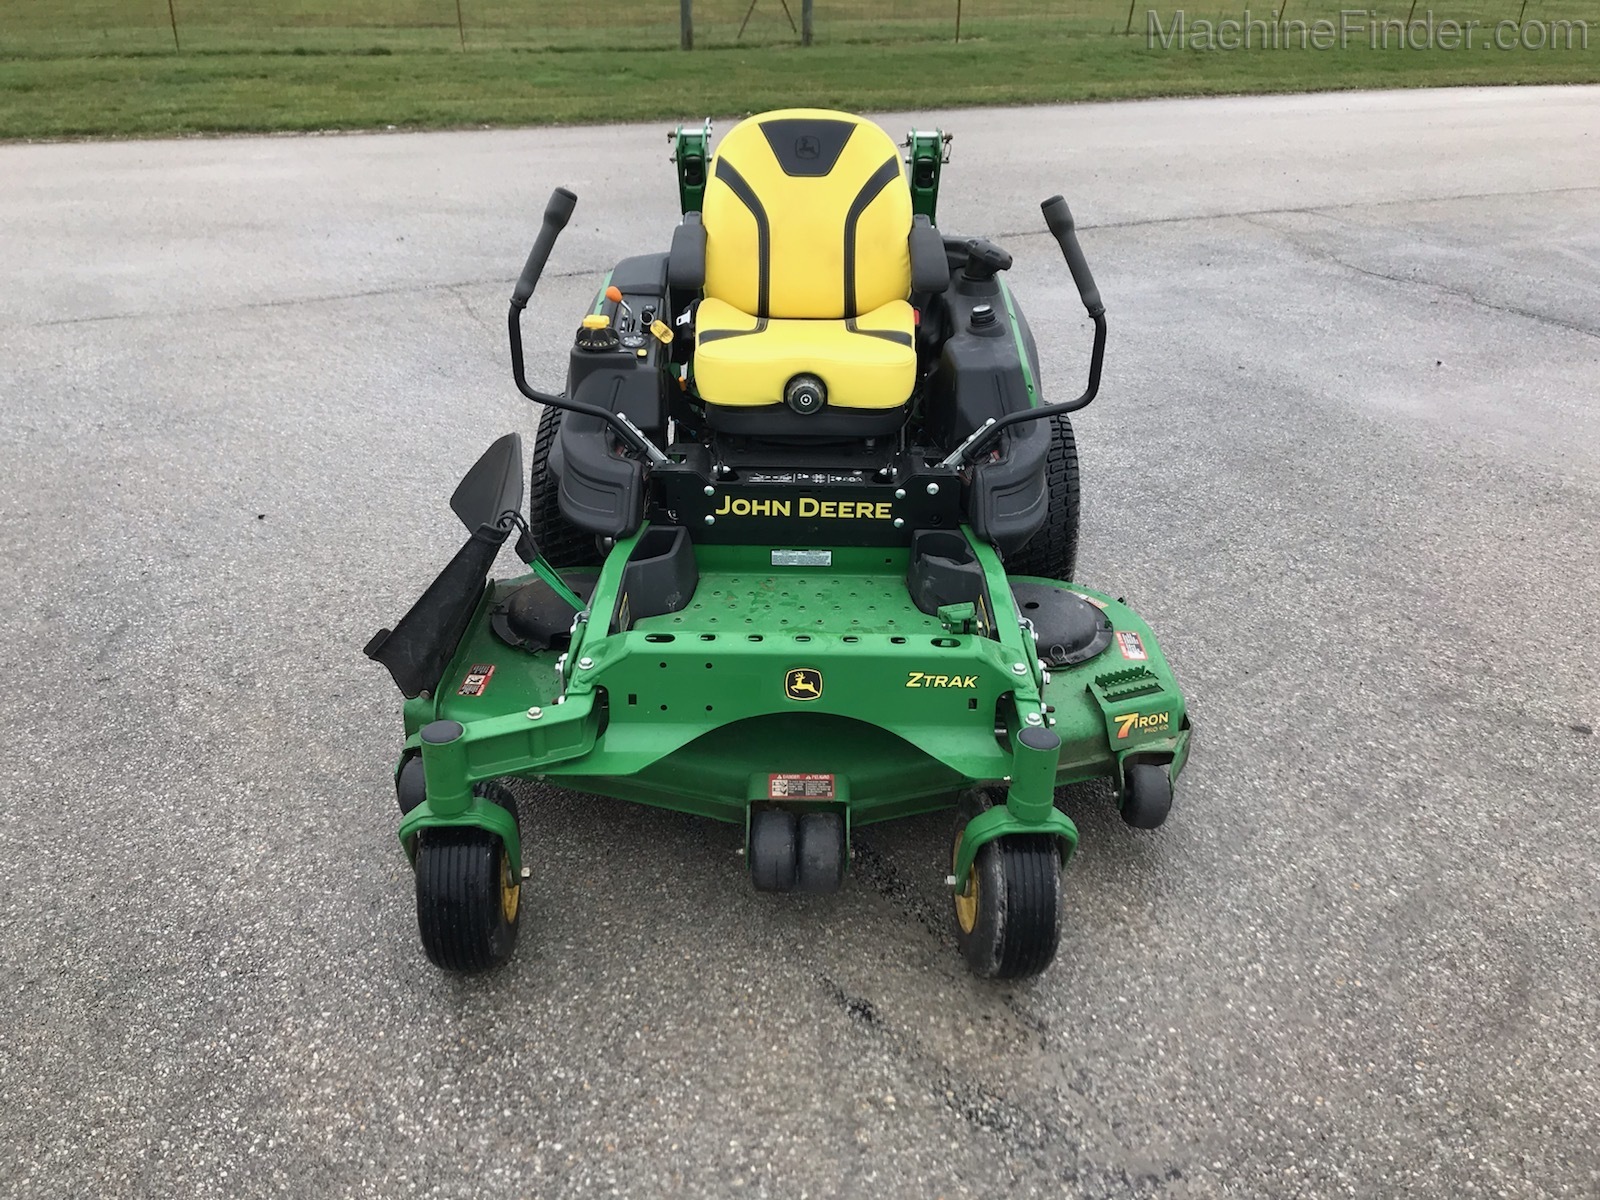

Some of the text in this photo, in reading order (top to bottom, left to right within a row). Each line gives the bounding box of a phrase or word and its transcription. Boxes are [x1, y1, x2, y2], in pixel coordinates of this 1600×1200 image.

[715, 495, 892, 519] JOHN DEERE
[906, 672, 978, 689] ZTRAK
